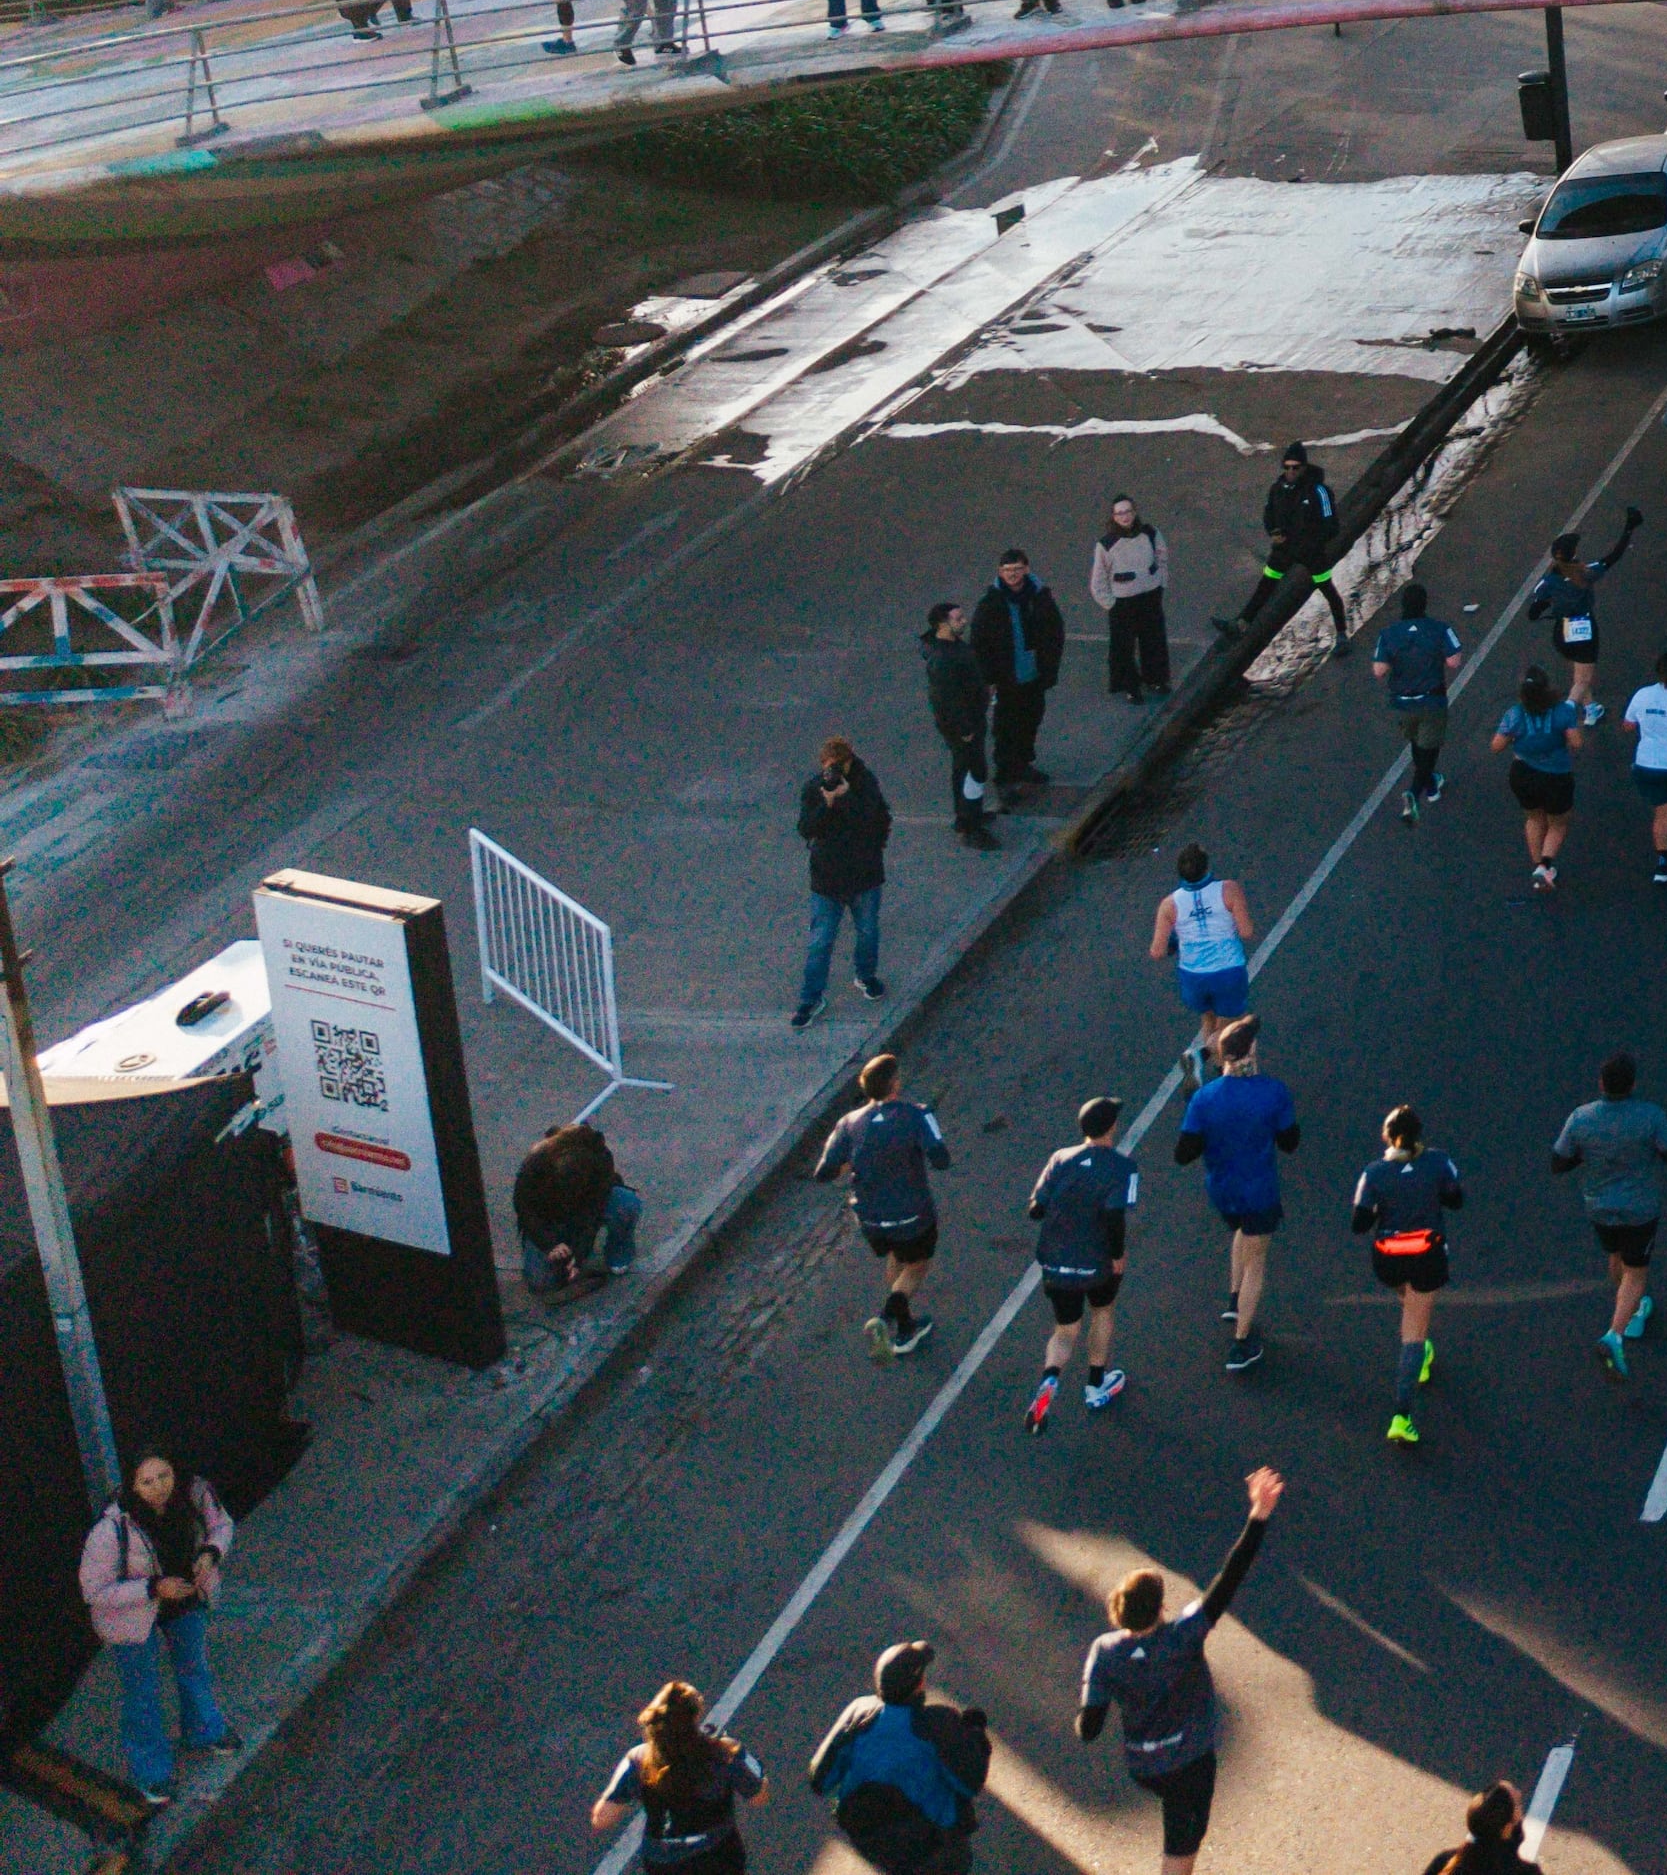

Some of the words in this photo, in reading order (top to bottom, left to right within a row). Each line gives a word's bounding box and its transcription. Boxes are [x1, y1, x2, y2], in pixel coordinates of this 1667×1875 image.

[291, 954, 305, 964] EN
[295, 940, 338, 958] QUERÉS
[341, 951, 384, 968] PAUTAR
[341, 978, 367, 991] ESTE
[370, 985, 386, 996] QR
